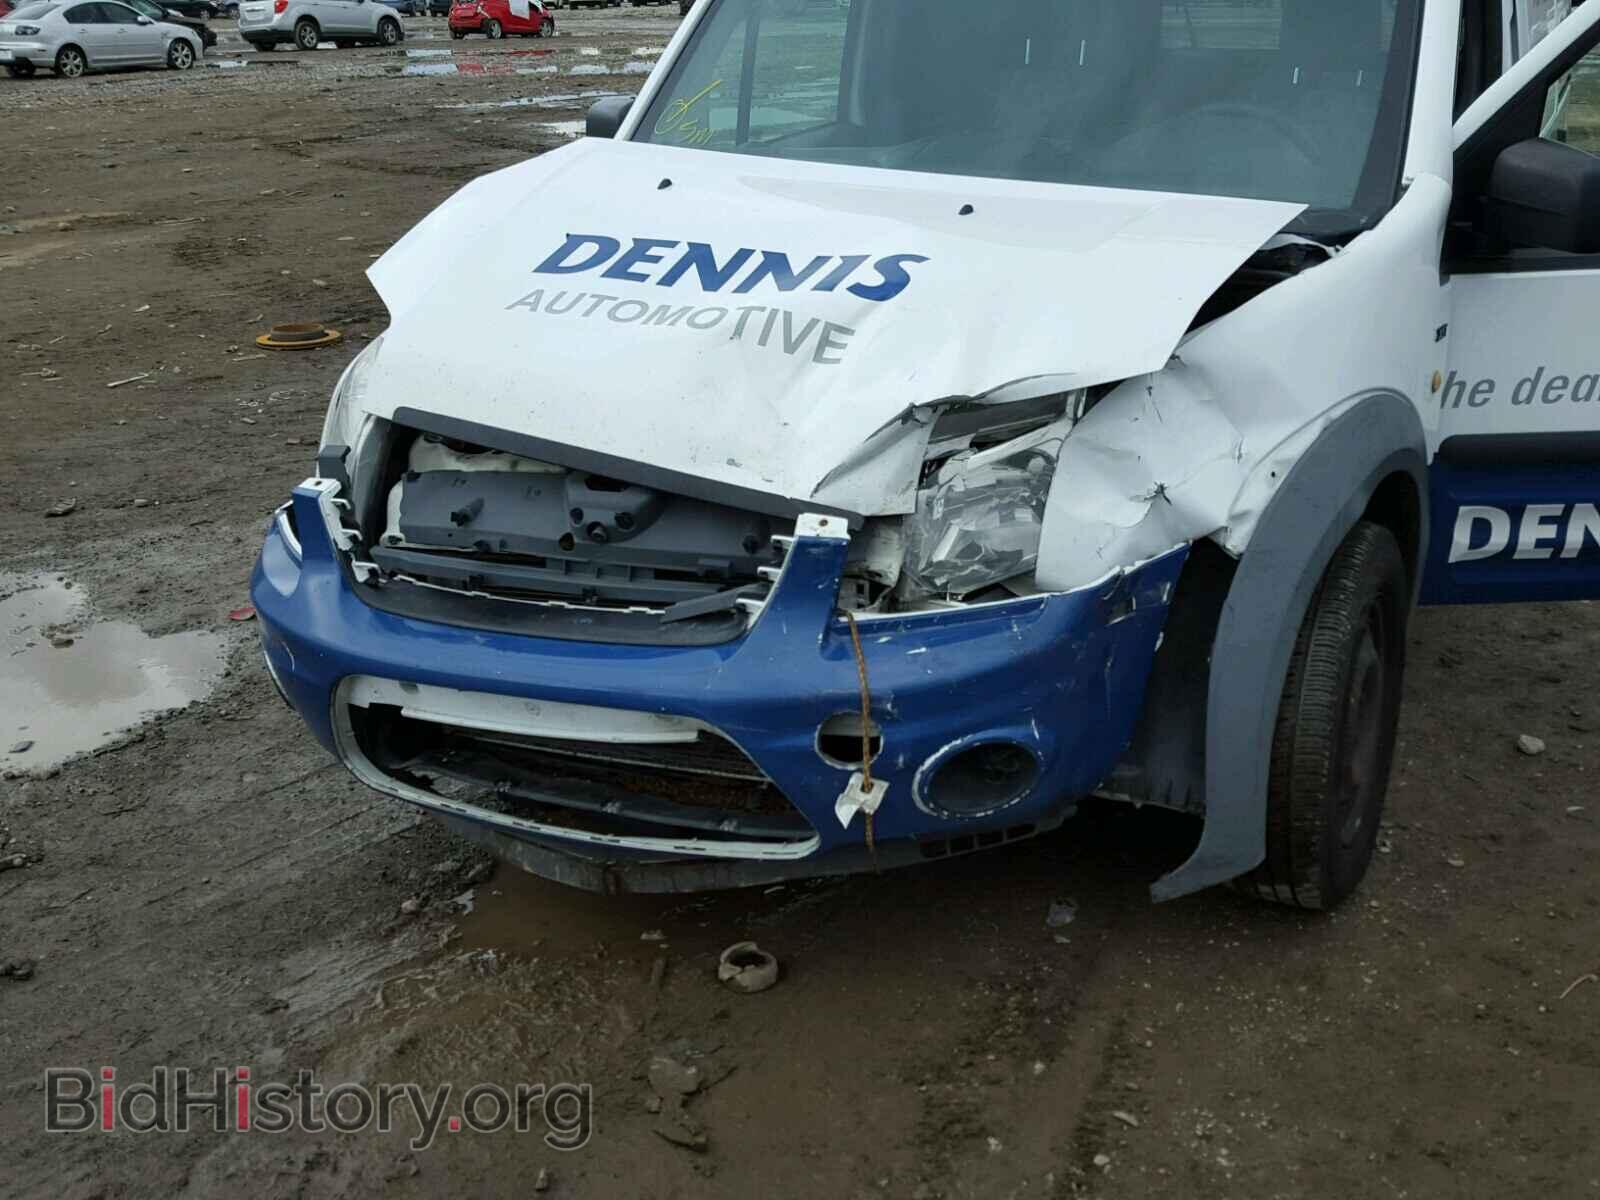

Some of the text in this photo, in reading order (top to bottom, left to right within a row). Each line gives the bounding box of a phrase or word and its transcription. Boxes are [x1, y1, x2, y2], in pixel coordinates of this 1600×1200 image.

[532, 232, 931, 302] DENNIS
[504, 287, 856, 365] AUTOMOTIVE
[1511, 366, 1600, 405] dea
